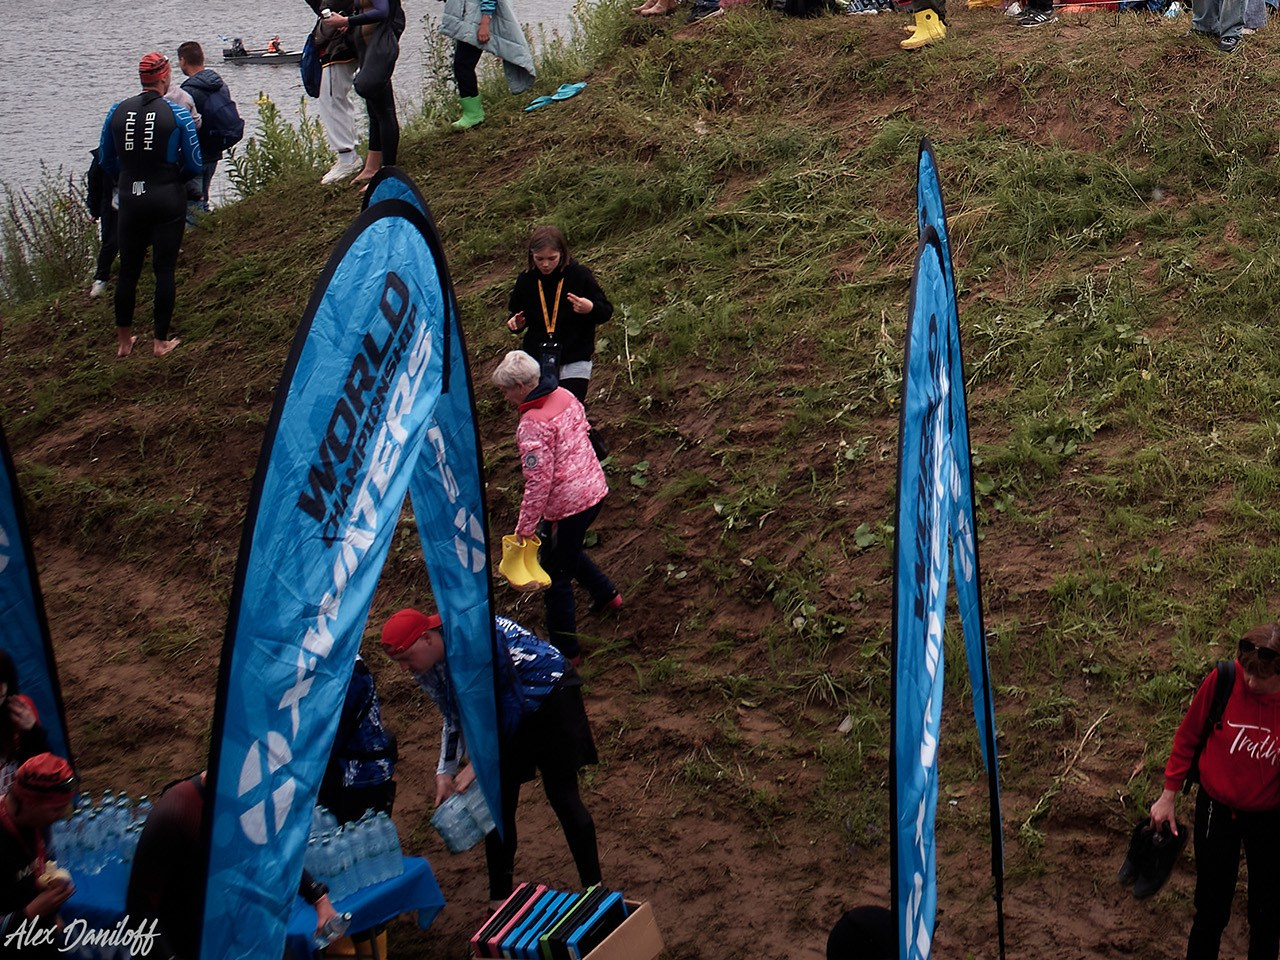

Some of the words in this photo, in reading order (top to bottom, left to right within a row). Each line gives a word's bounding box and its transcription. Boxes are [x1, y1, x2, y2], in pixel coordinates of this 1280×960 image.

[125, 111, 138, 151] HUUB
[143, 112, 156, 151] HUUB
[295, 271, 410, 524] WORLD
[322, 303, 417, 548] CHAMPIONSHIP
